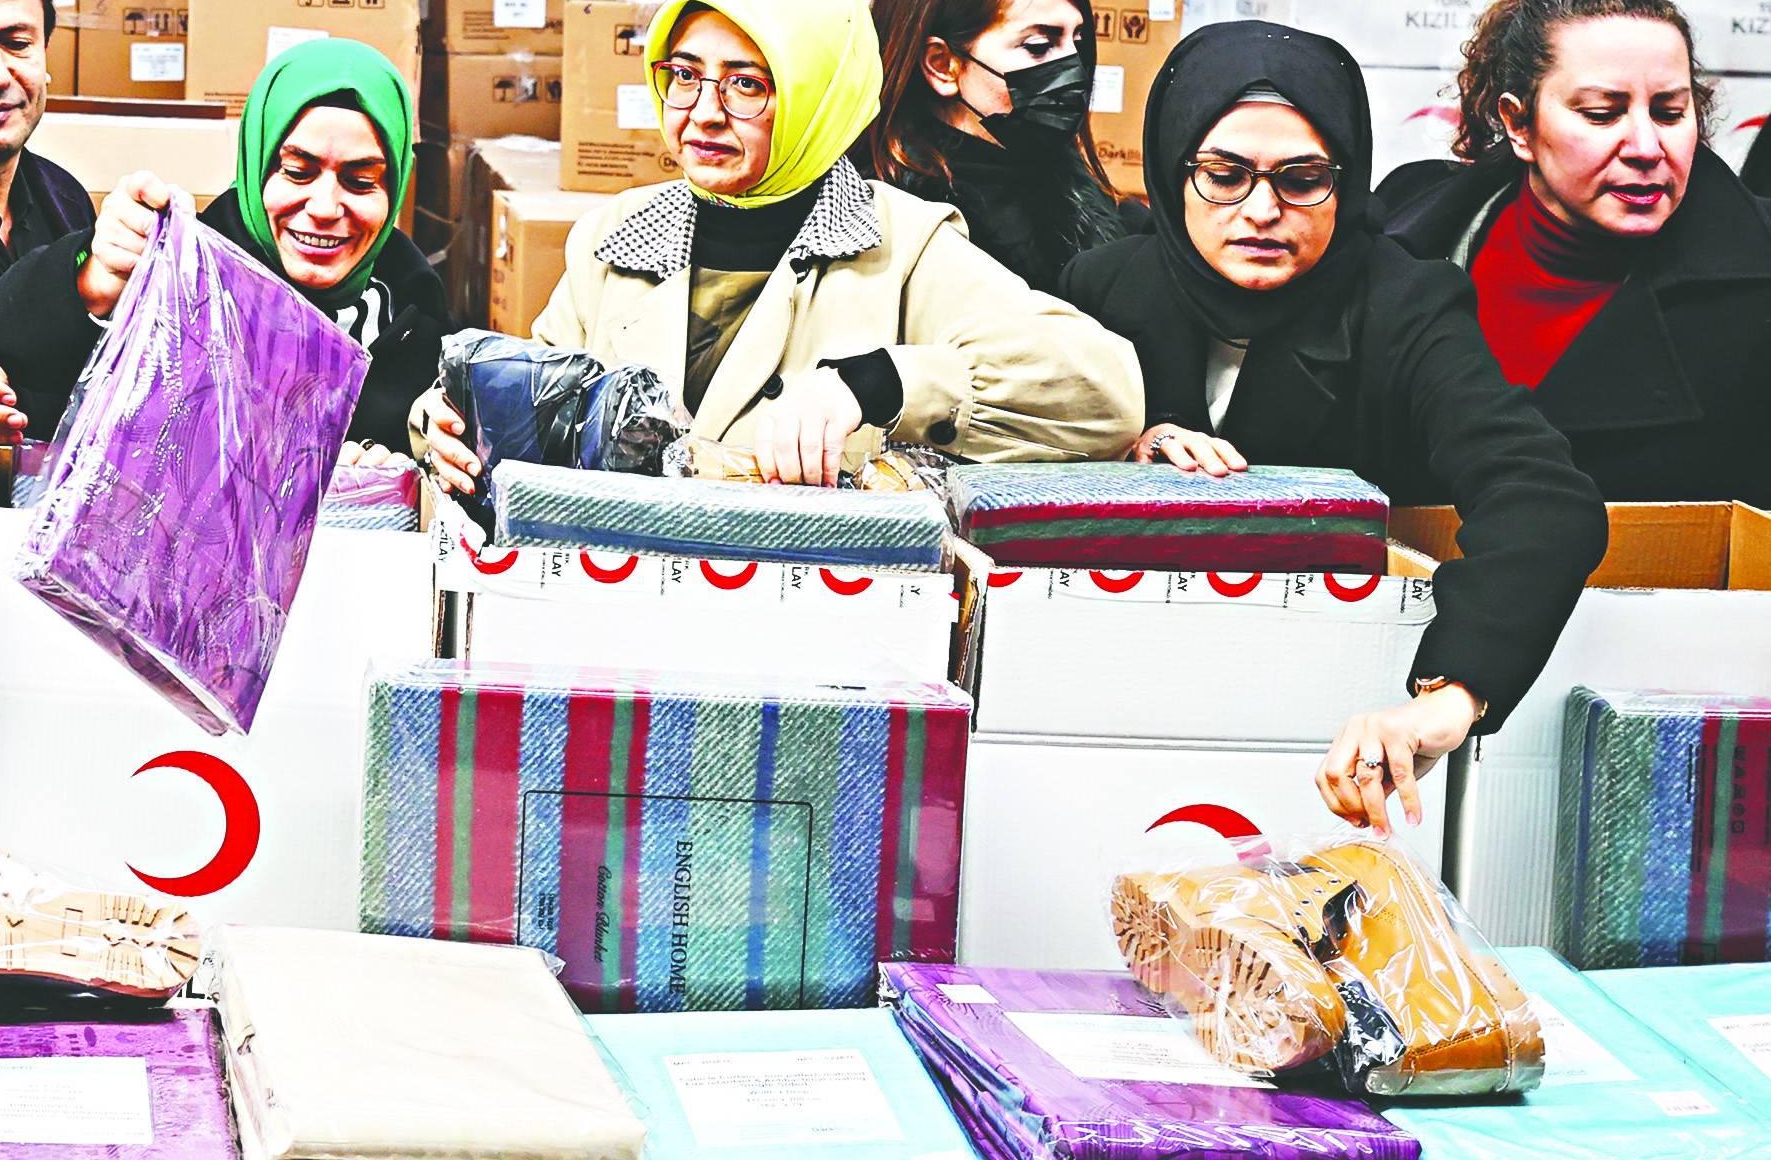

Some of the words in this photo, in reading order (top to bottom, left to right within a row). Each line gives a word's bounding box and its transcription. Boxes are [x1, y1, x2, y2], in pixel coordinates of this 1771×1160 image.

[1405, 11, 1476, 29] KIZIL
[552, 551, 563, 577] ILAY
[595, 865, 612, 908] Cotton
[673, 841, 693, 927] ENGLISH
[594, 911, 610, 964] Blanket
[669, 933, 688, 994] HOME
